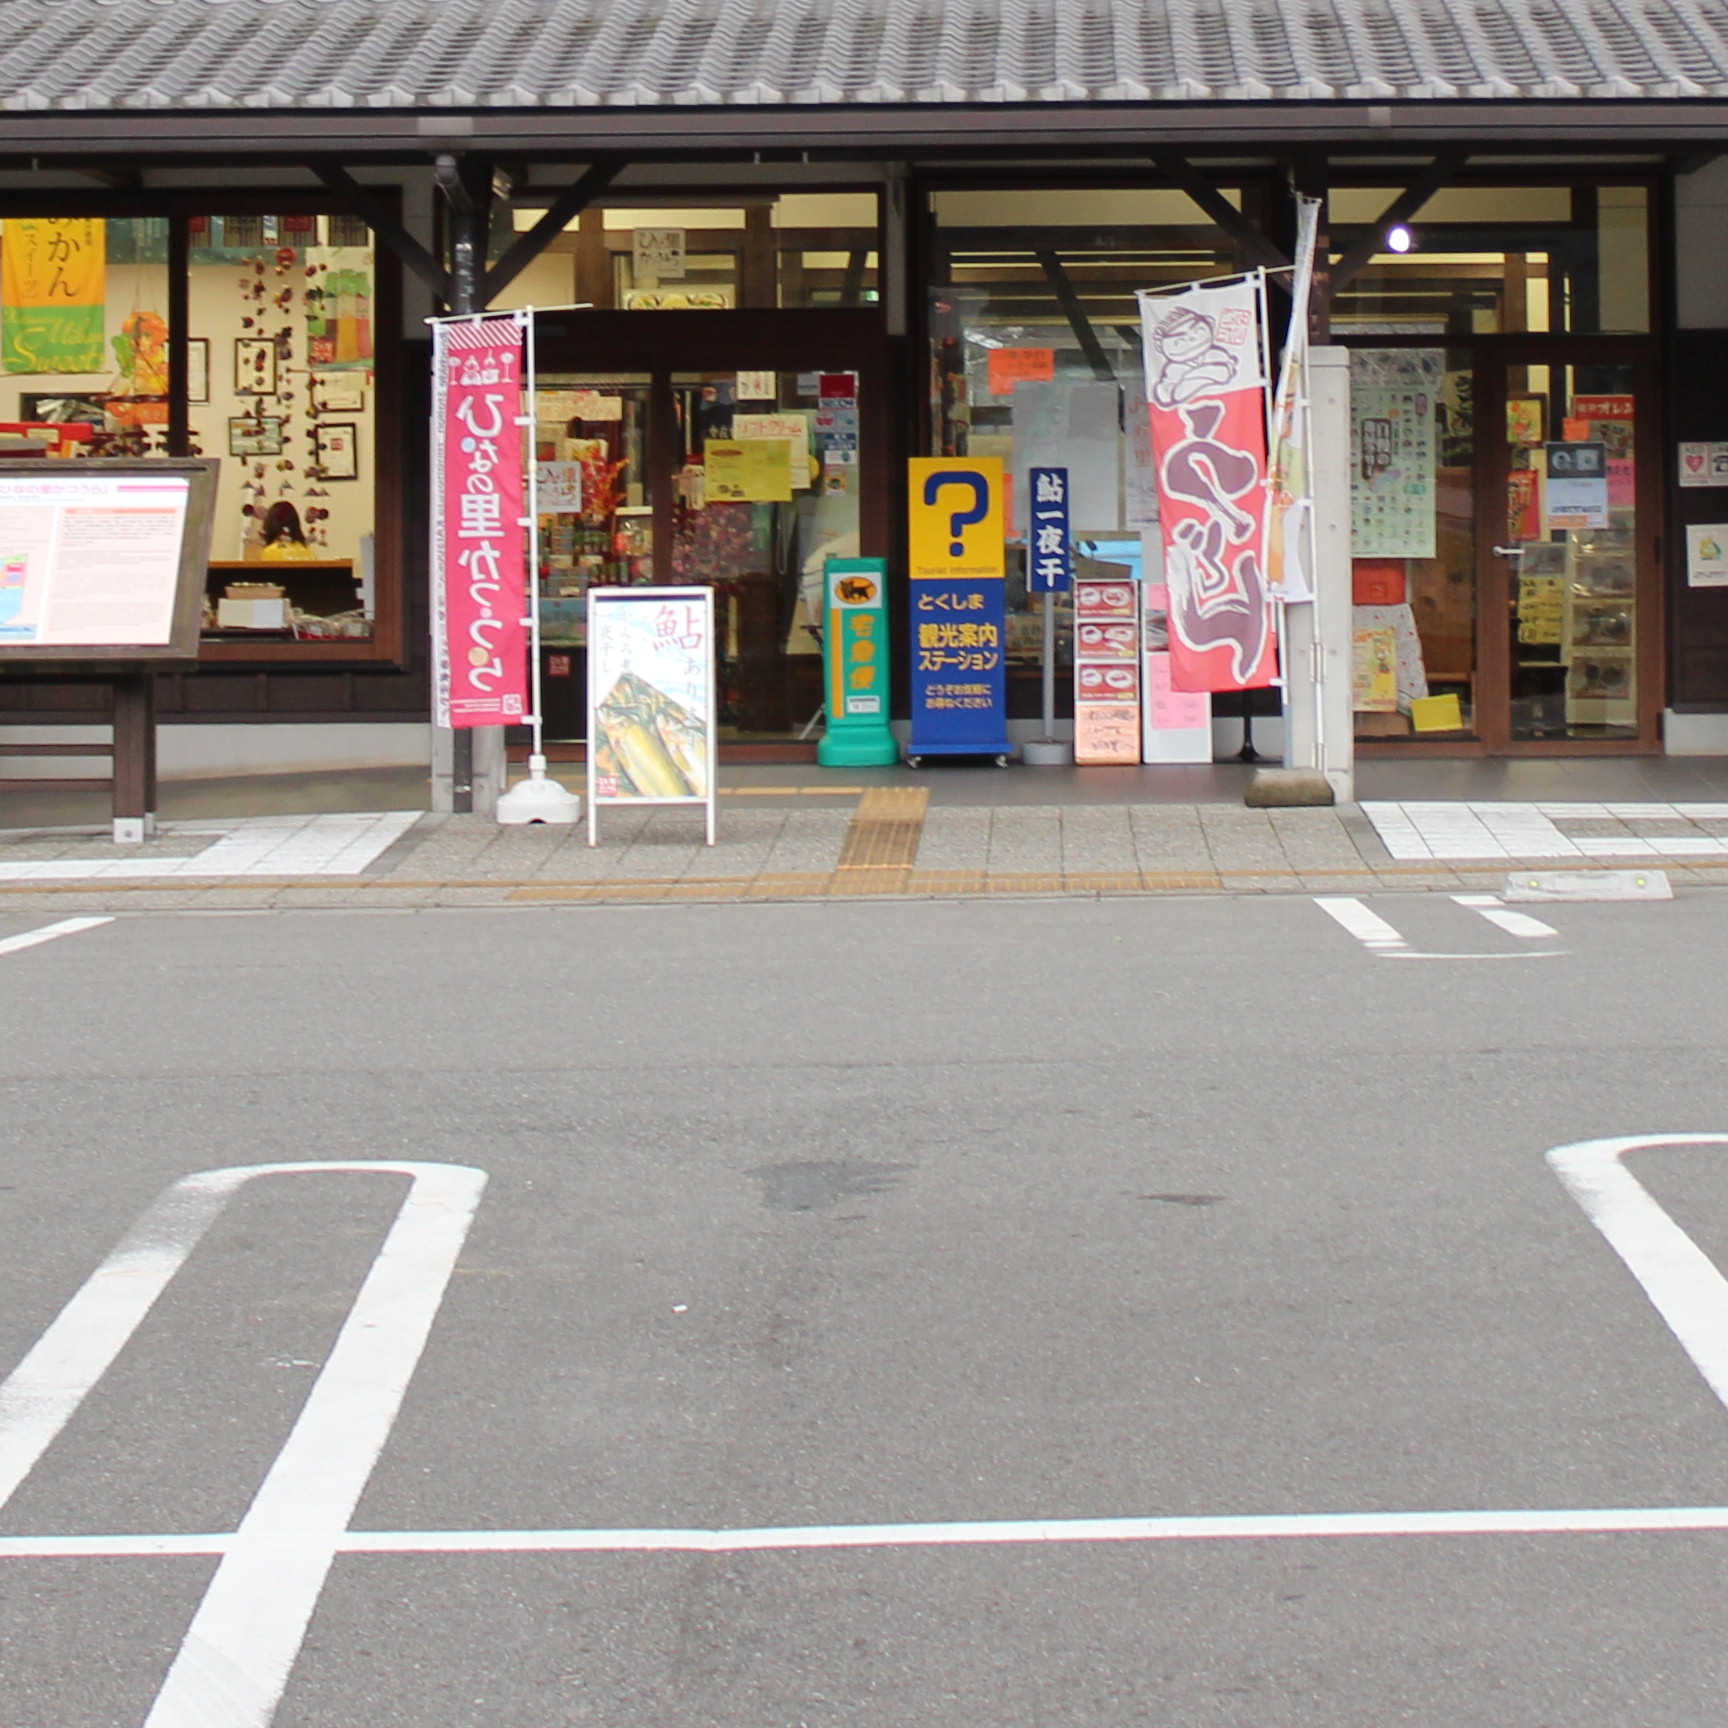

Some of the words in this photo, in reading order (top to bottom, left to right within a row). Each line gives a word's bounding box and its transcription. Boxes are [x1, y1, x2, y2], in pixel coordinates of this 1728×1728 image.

[1035, 473, 1066, 589] 鮎一夜干
[918, 593, 985, 610] とくしま
[653, 604, 703, 650] 鮎
[918, 622, 999, 648] 観光案内
[848, 613, 877, 690] 宅急便
[918, 650, 999, 671] ステーション
